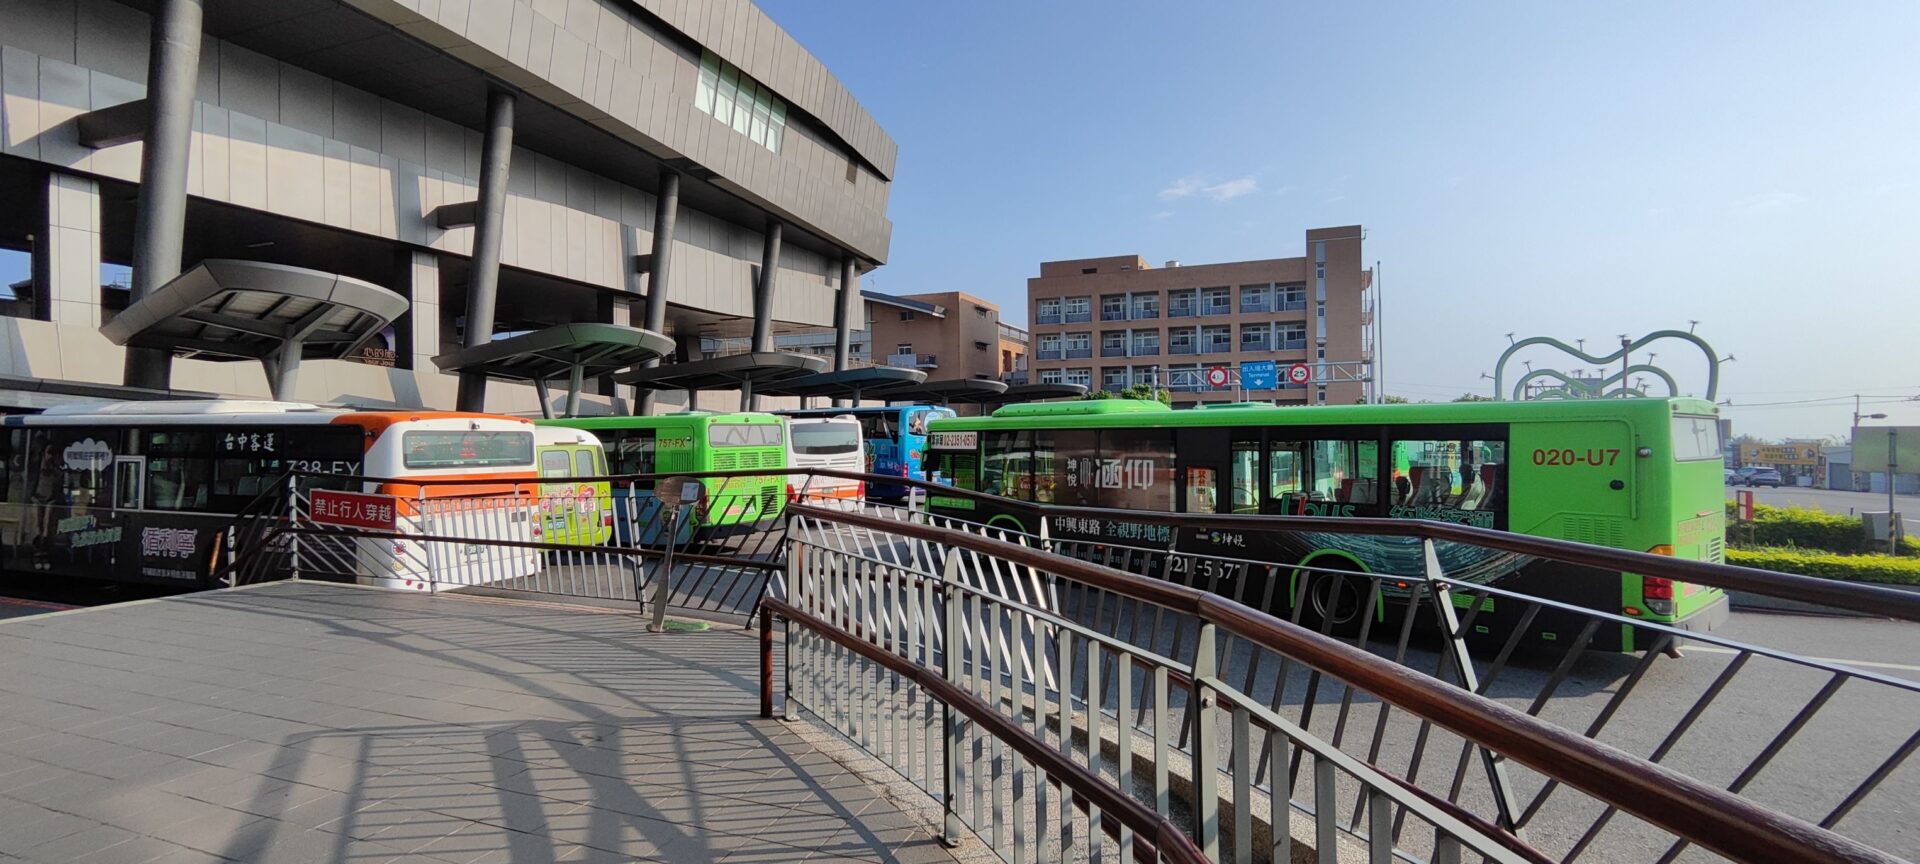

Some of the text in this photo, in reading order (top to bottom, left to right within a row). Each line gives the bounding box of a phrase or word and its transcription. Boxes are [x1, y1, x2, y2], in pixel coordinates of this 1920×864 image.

[224, 432, 275, 451] 台中客運
[658, 438, 686, 447] 757-FX
[943, 434, 977, 447] 02-2351-0578
[1532, 449, 1620, 466] 020-U7
[1066, 458, 1077, 487] 坤悅
[1095, 459, 1154, 490] 涵仰
[314, 498, 392, 522] 禁止行人穿越
[1055, 516, 1170, 542] 中興東路 全視野地標
